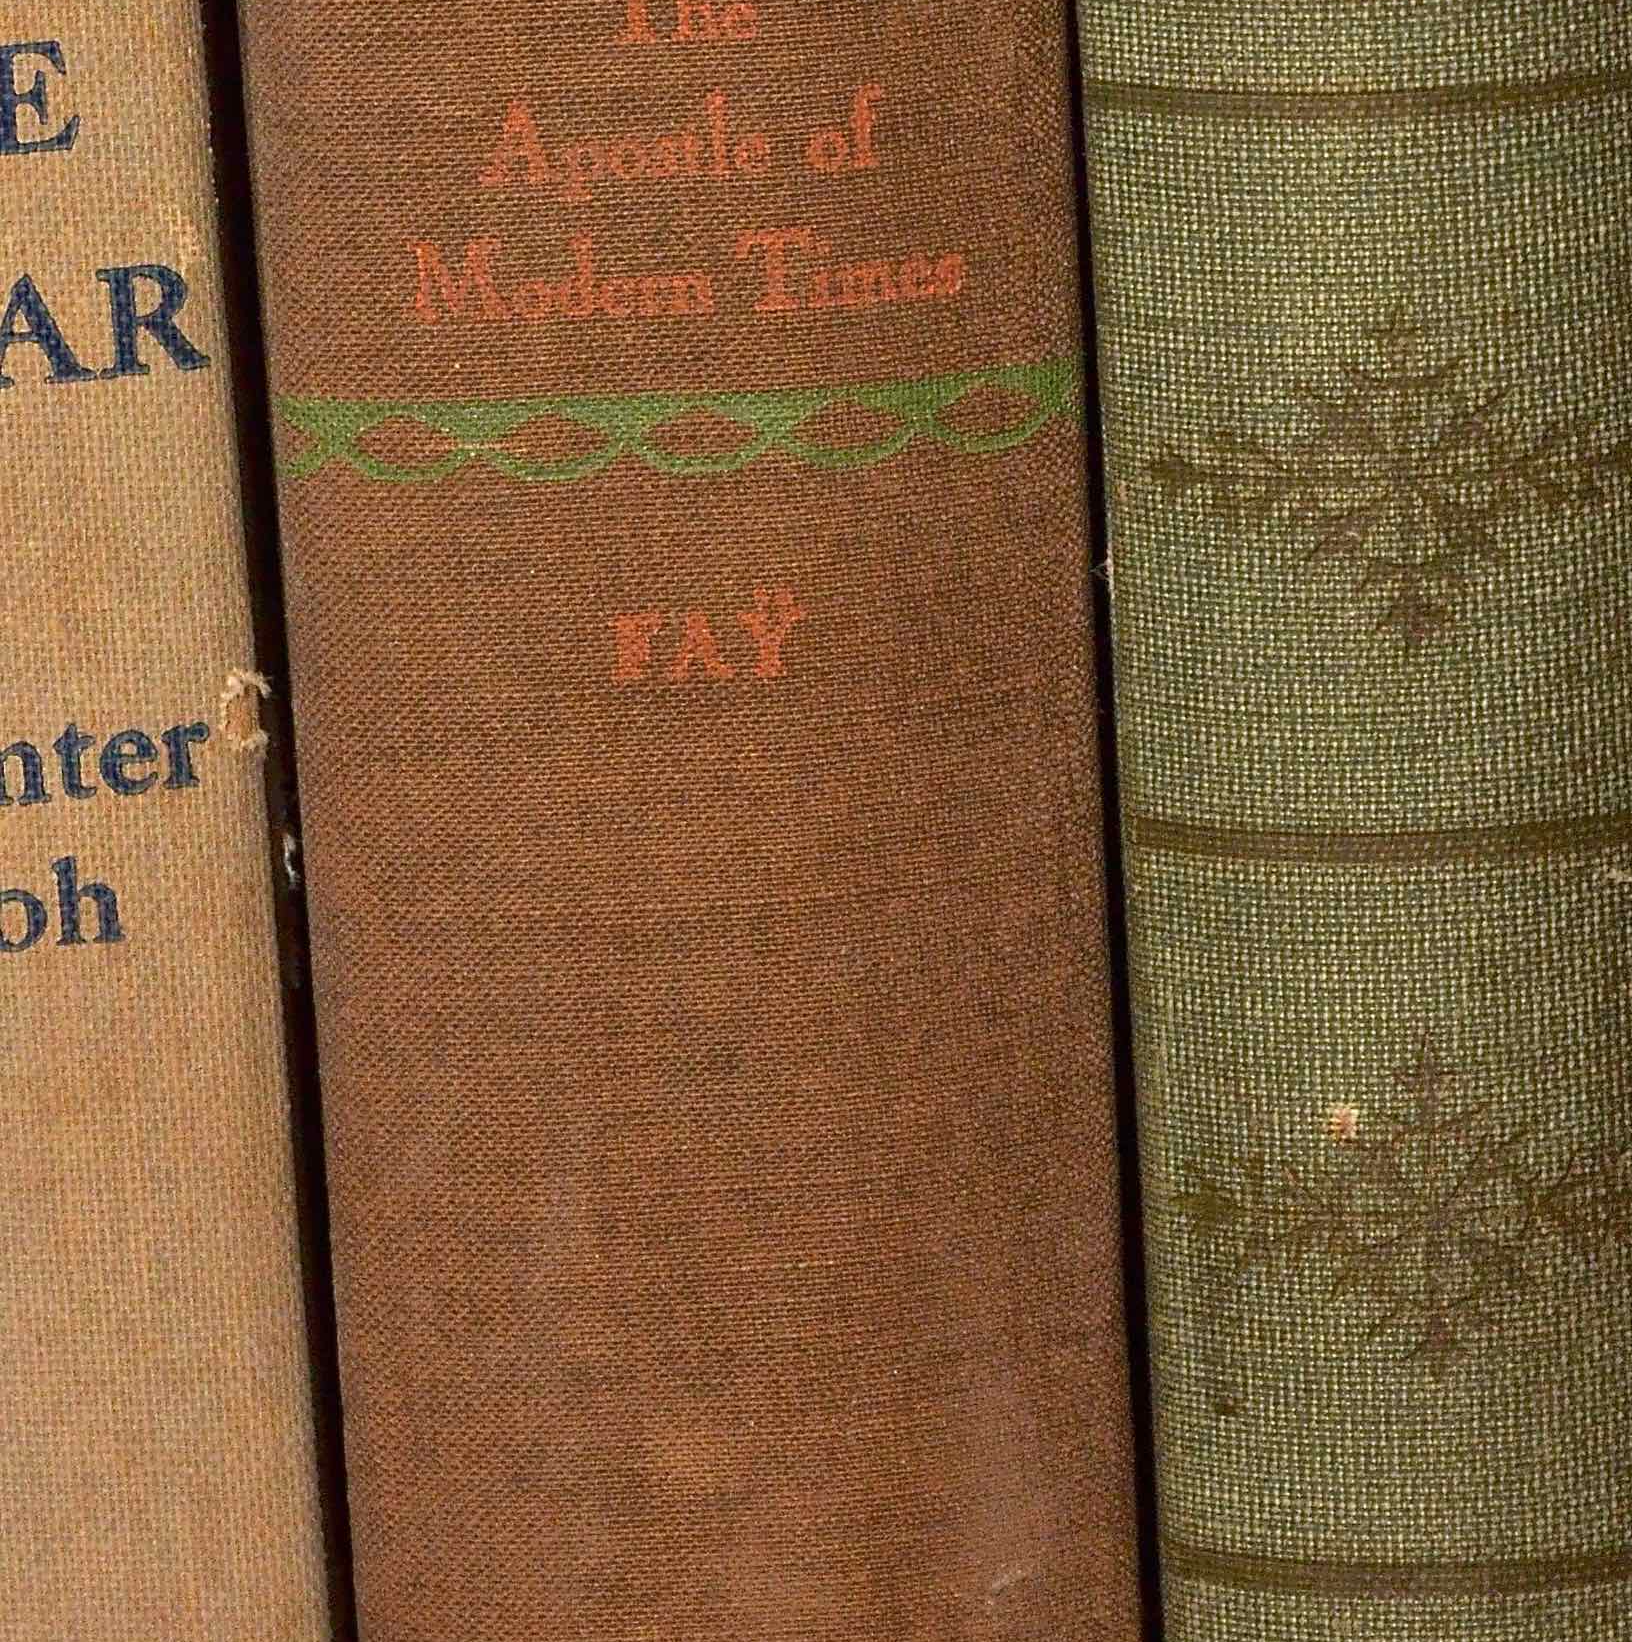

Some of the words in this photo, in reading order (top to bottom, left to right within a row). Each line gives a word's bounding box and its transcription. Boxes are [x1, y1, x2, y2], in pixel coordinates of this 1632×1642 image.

[478, 86, 770, 203] Apostle
[808, 83, 883, 174] of
[402, 231, 715, 325] Modern
[735, 225, 965, 314] Times
